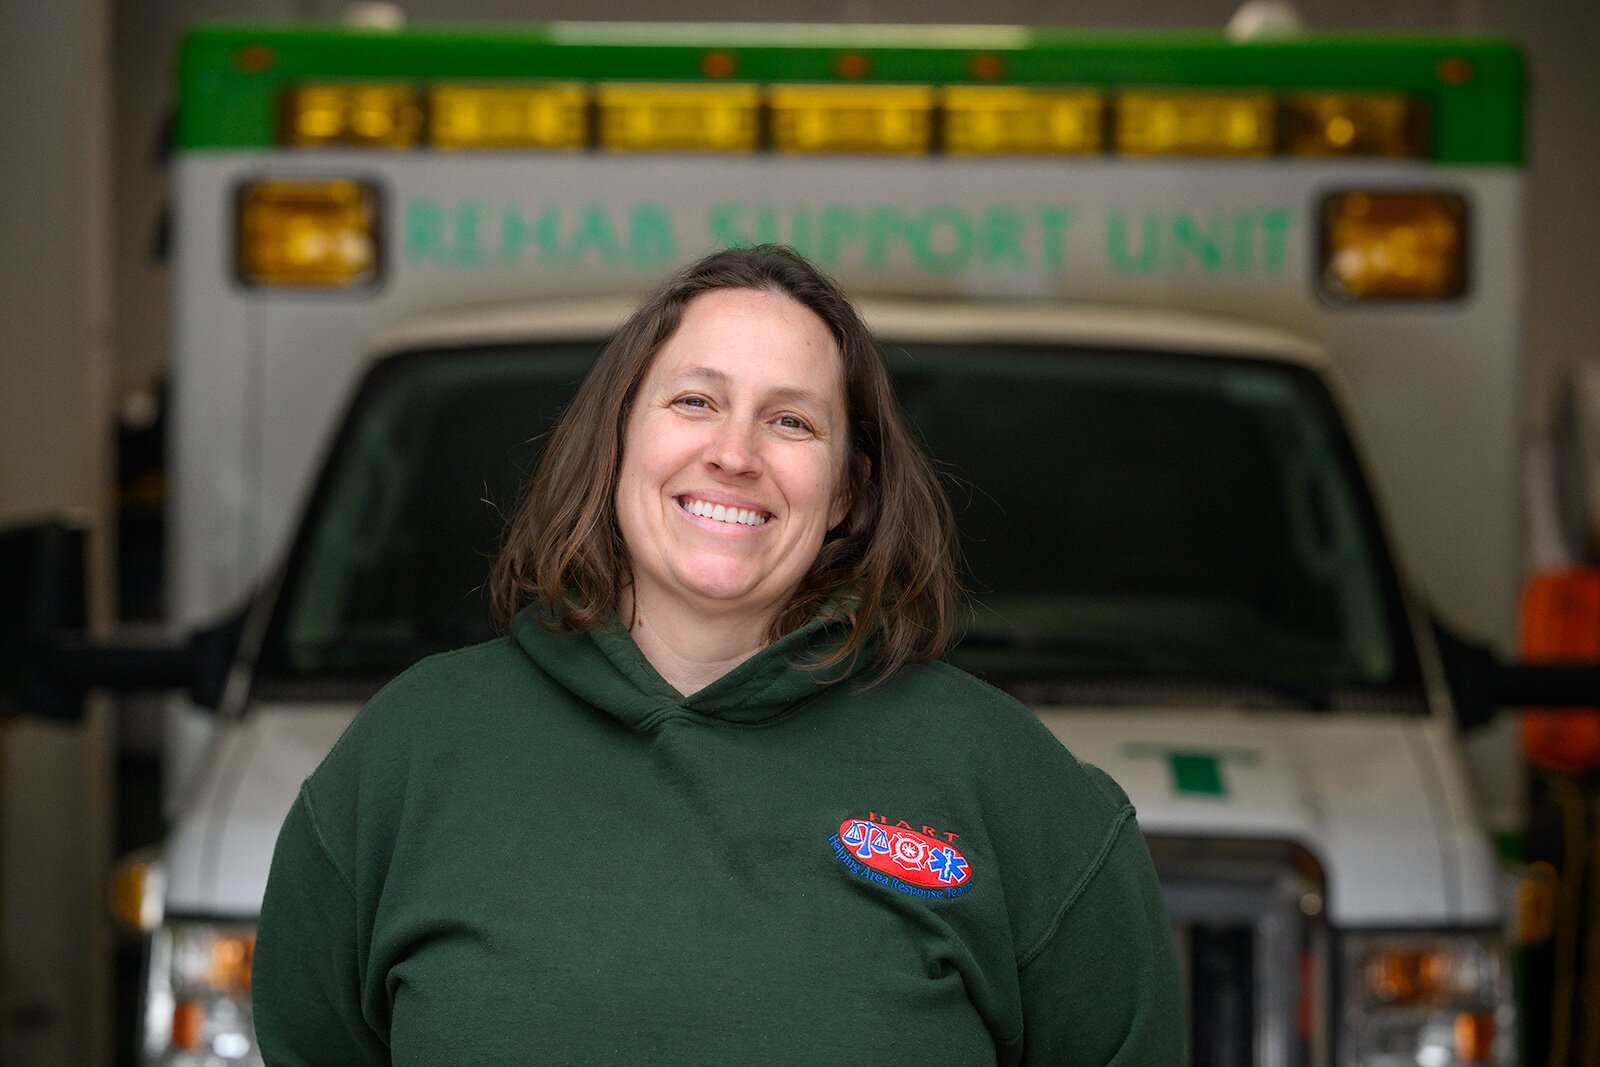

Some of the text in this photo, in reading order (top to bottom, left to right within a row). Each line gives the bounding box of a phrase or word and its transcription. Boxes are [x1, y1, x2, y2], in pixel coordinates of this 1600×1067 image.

[405, 201, 1297, 276] REHAB SUPPORT UNIT
[869, 811, 959, 842] HART
[828, 834, 861, 876] Helping
[860, 866, 890, 886] Area
[890, 877, 945, 899] Response
